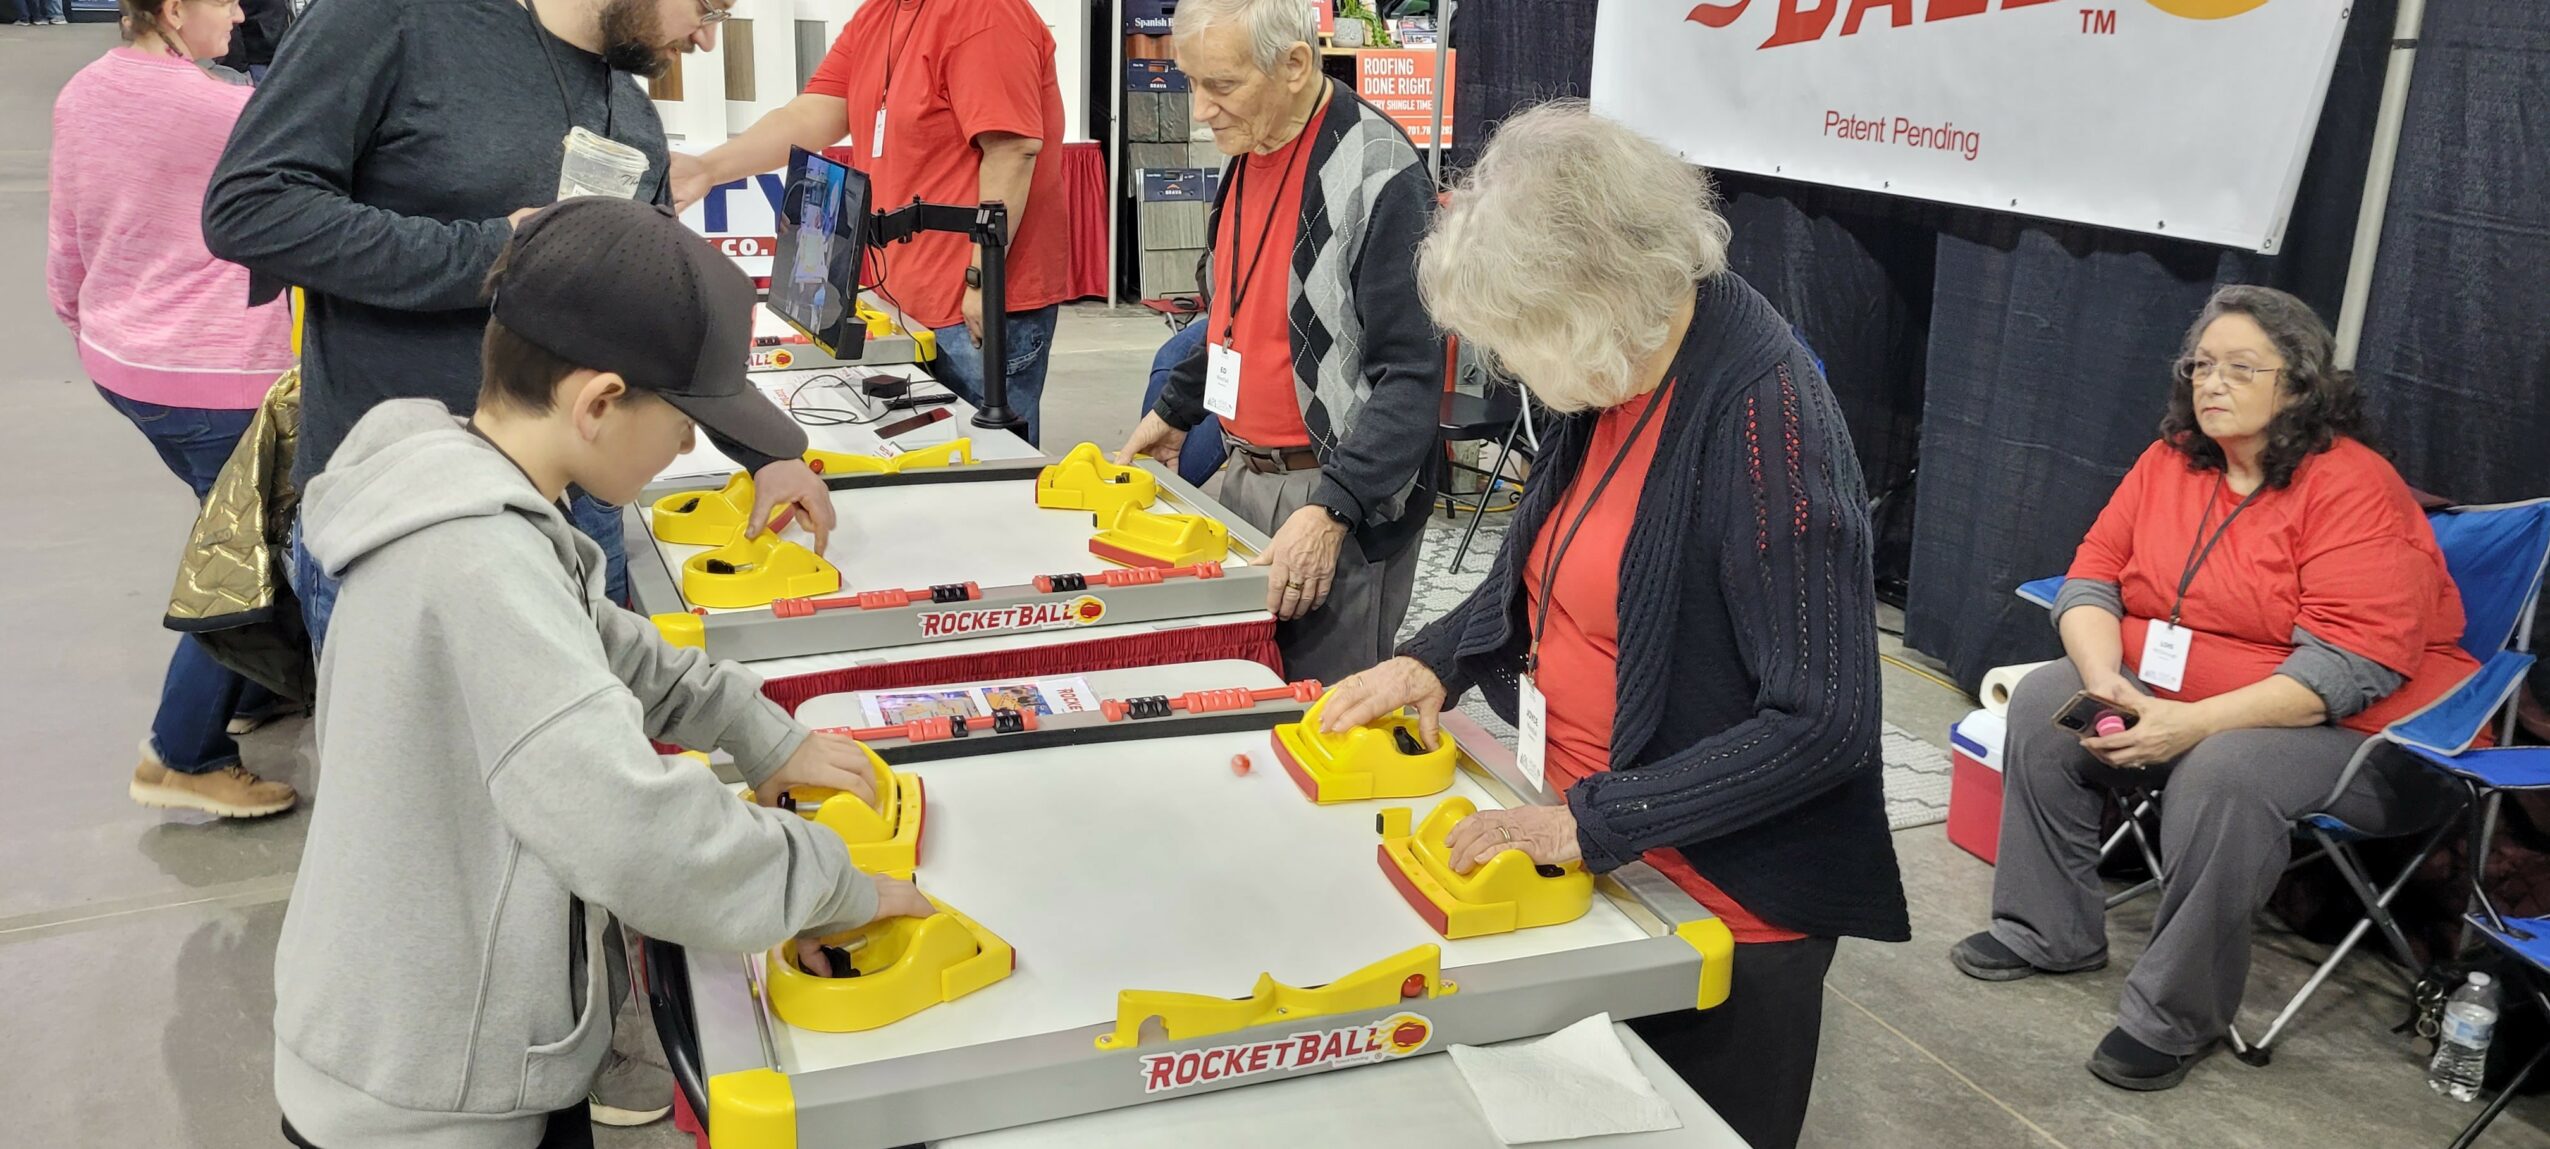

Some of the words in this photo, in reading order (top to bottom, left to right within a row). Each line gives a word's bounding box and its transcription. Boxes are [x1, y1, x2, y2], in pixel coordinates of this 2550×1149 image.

[1134, 17, 1167, 29] Spanish
[2079, 9, 2117, 35] TM
[1364, 57, 1414, 75] ROOFING
[1364, 77, 1395, 95] DONE
[1398, 77, 1433, 95] RIGHT.
[1386, 99, 1417, 111] SHINGLE
[1823, 110, 1887, 143] Patent
[1892, 117, 1980, 161] Pending
[721, 238, 769, 257] CO.
[920, 603, 1074, 636] ROCKETBALL
[1056, 686, 1084, 712] ROCKE
[1147, 1027, 1382, 1090] ROCKETBALL
